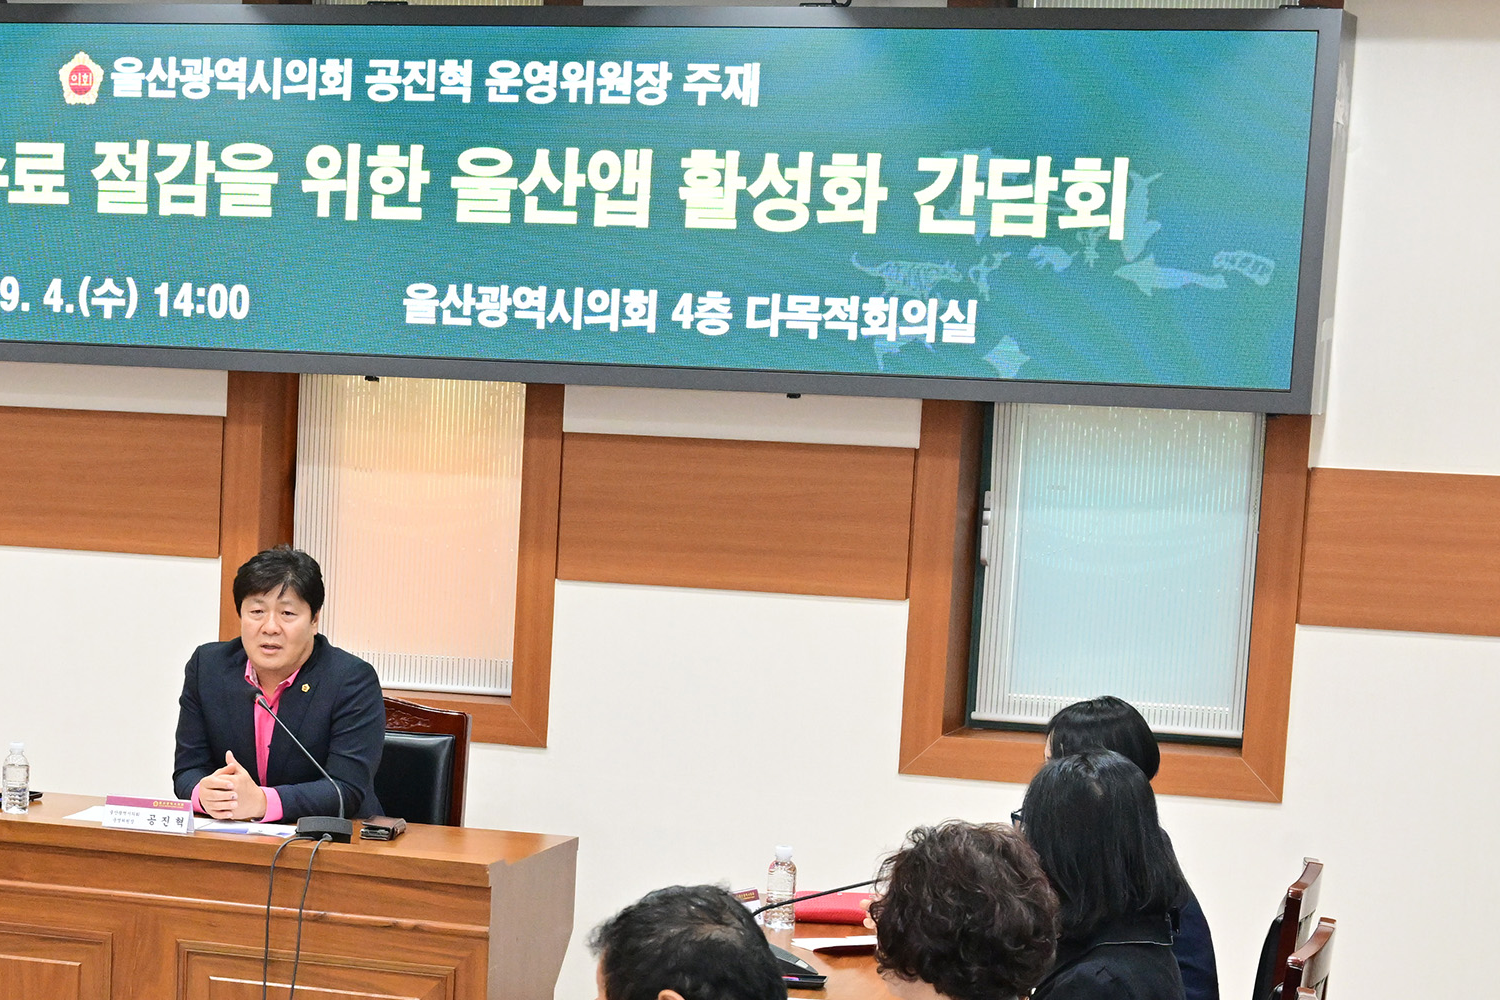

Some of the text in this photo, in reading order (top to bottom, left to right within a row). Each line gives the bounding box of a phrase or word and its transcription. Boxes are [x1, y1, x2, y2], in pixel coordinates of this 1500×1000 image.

[70, 73, 93, 87] 의회
[110, 56, 761, 108] 울산광역시의회 공진혁 운영위원장 주재
[90, 139, 279, 218] 절감을
[301, 143, 425, 221] 위한
[450, 147, 654, 229] 울산앱
[678, 149, 889, 234] 활성화
[913, 153, 1130, 241] 간담회
[0, 275, 30, 312] 9.
[43, 275, 139, 320] 4.(수)
[154, 282, 250, 320] 14:00
[402, 282, 978, 344] 울산광역시의회 4층 다목적회의실
[146, 814, 185, 828] 공진혁
